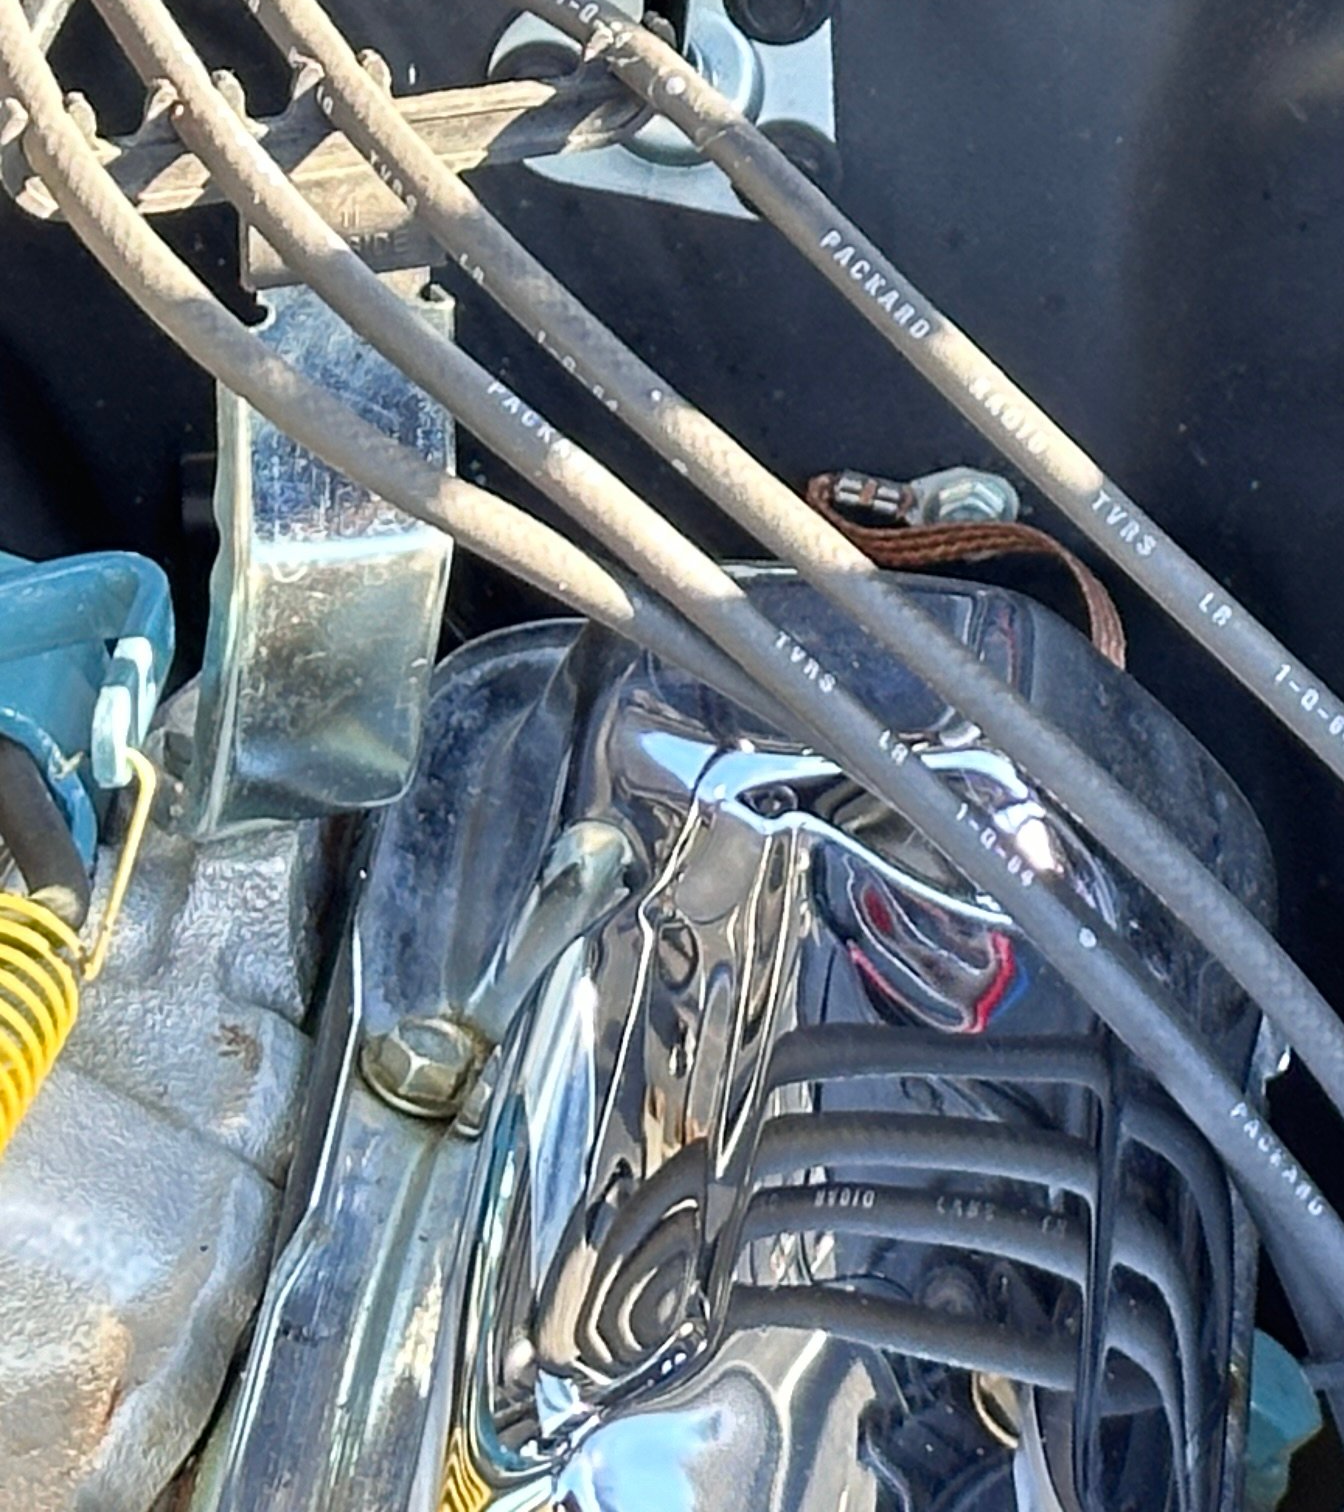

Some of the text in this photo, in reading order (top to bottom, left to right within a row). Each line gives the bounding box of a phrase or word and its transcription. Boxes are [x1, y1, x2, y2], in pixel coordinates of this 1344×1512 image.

[818, 228, 933, 340] PACKARD
[1090, 489, 1158, 557] TVRS
[1198, 591, 1233, 626] LR
